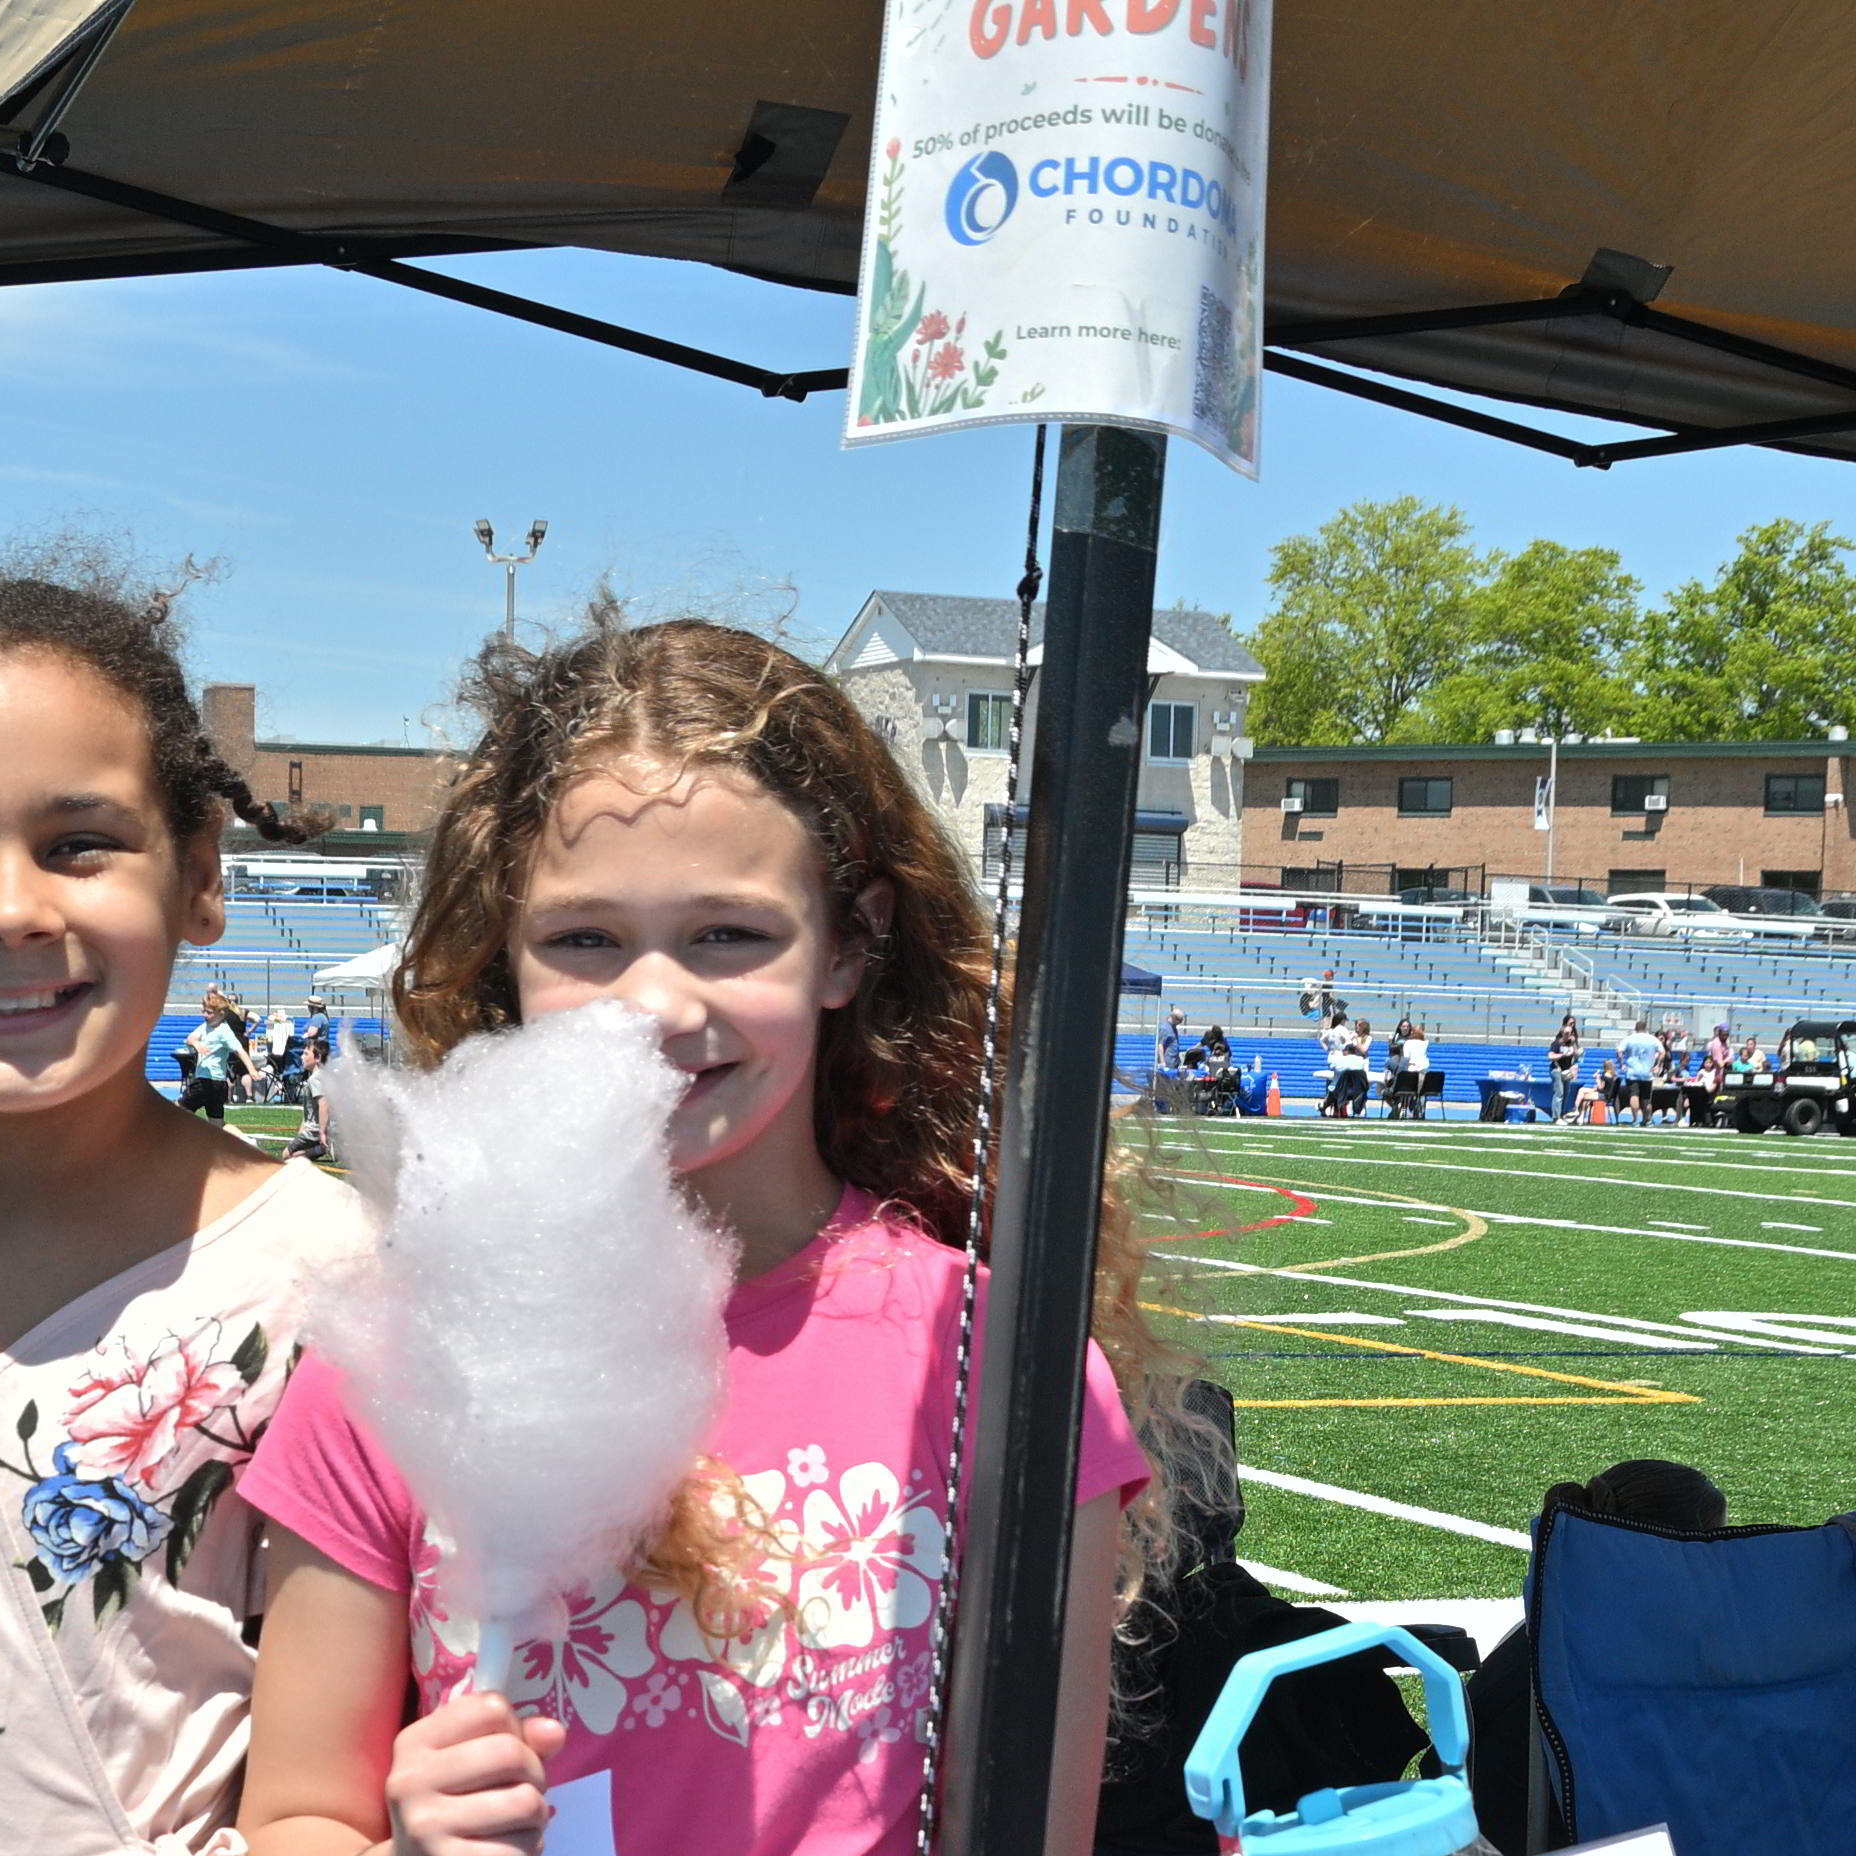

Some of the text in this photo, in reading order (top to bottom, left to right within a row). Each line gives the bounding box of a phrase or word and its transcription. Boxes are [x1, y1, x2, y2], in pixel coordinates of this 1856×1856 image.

[912, 133, 954, 160] 50%
[959, 125, 981, 148] of
[984, 104, 1093, 145] proceeds
[1101, 104, 1149, 128] will
[1158, 108, 1187, 133] be
[1016, 324, 1182, 351] Learn more here:
